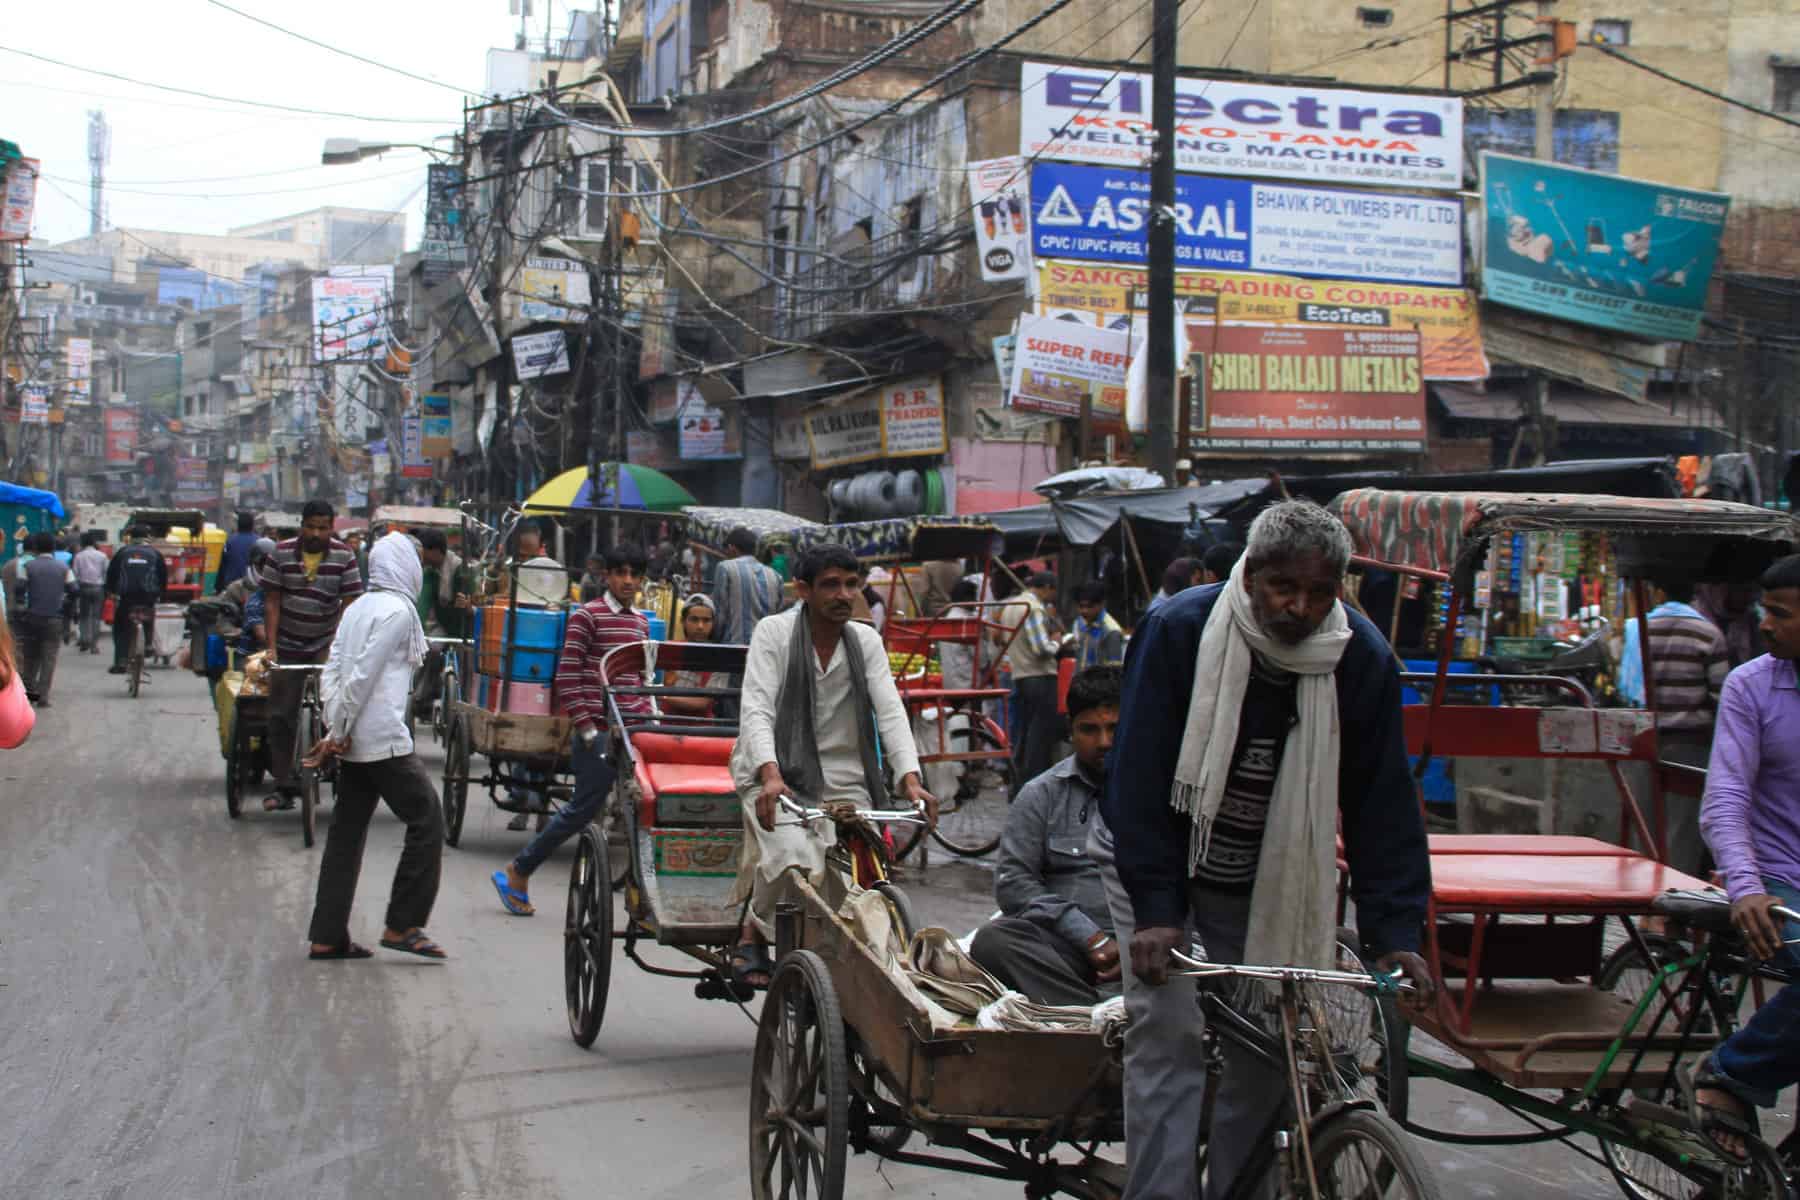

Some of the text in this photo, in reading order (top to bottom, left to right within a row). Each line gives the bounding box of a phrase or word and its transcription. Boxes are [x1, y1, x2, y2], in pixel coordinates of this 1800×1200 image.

[1046, 72, 1443, 138] Electra
[1050, 127, 1445, 169] WELDNG MACHINES
[1087, 196, 1248, 241] ASRAL
[1256, 191, 1457, 225] BHAVIK POLYMERS PVT. LTD.
[1039, 235, 1071, 250] CPVC
[1079, 237, 1108, 252] UPVC
[1204, 247, 1245, 263] VALVES
[1179, 275, 1315, 301] TRADING
[1325, 285, 1469, 311] COMPANY
[1306, 304, 1384, 325] EcoTech
[1025, 337, 1086, 361] SUPER
[1211, 354, 1421, 394] SHRI BALAJI METALS
